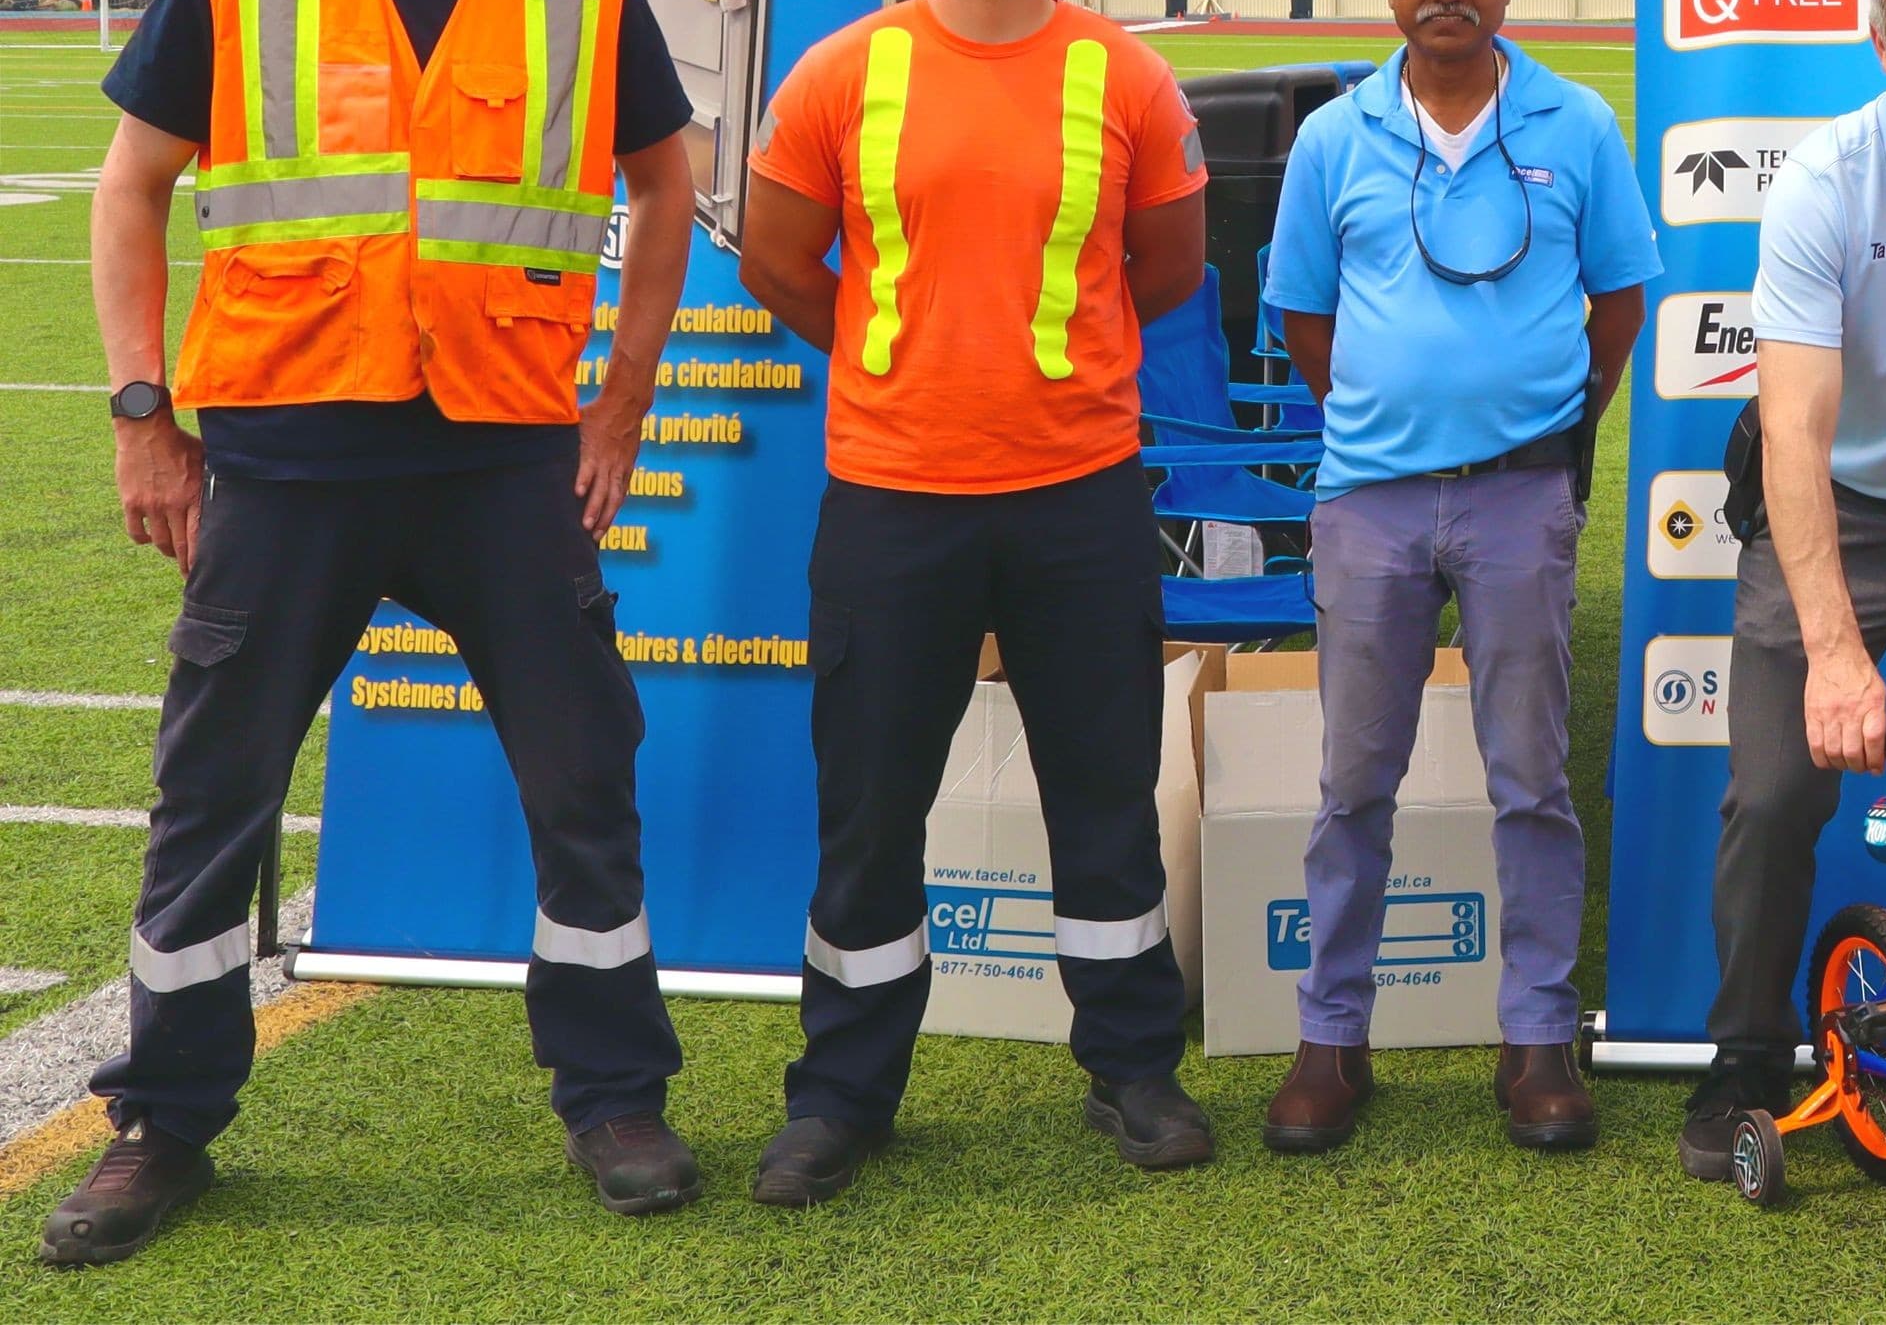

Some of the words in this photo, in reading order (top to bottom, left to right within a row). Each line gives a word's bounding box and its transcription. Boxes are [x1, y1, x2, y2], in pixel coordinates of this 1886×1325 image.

[671, 304, 772, 334] rculation
[1694, 303, 1757, 354] Ene
[677, 358, 801, 389] circulation
[660, 412, 742, 444] priorité
[629, 466, 684, 497] tions
[357, 622, 458, 654] Systèmes
[616, 631, 678, 662] laires
[682, 638, 698, 664] &
[702, 633, 809, 668] électriqu
[352, 675, 456, 709] Systèmes
[933, 867, 1037, 884] www.tacel.ca
[1385, 875, 1432, 889] cel.ca
[931, 897, 990, 929] cel
[1273, 909, 1312, 943] Ta
[934, 961, 1045, 980] -877-750-4646
[1373, 971, 1442, 986] 50-4646
